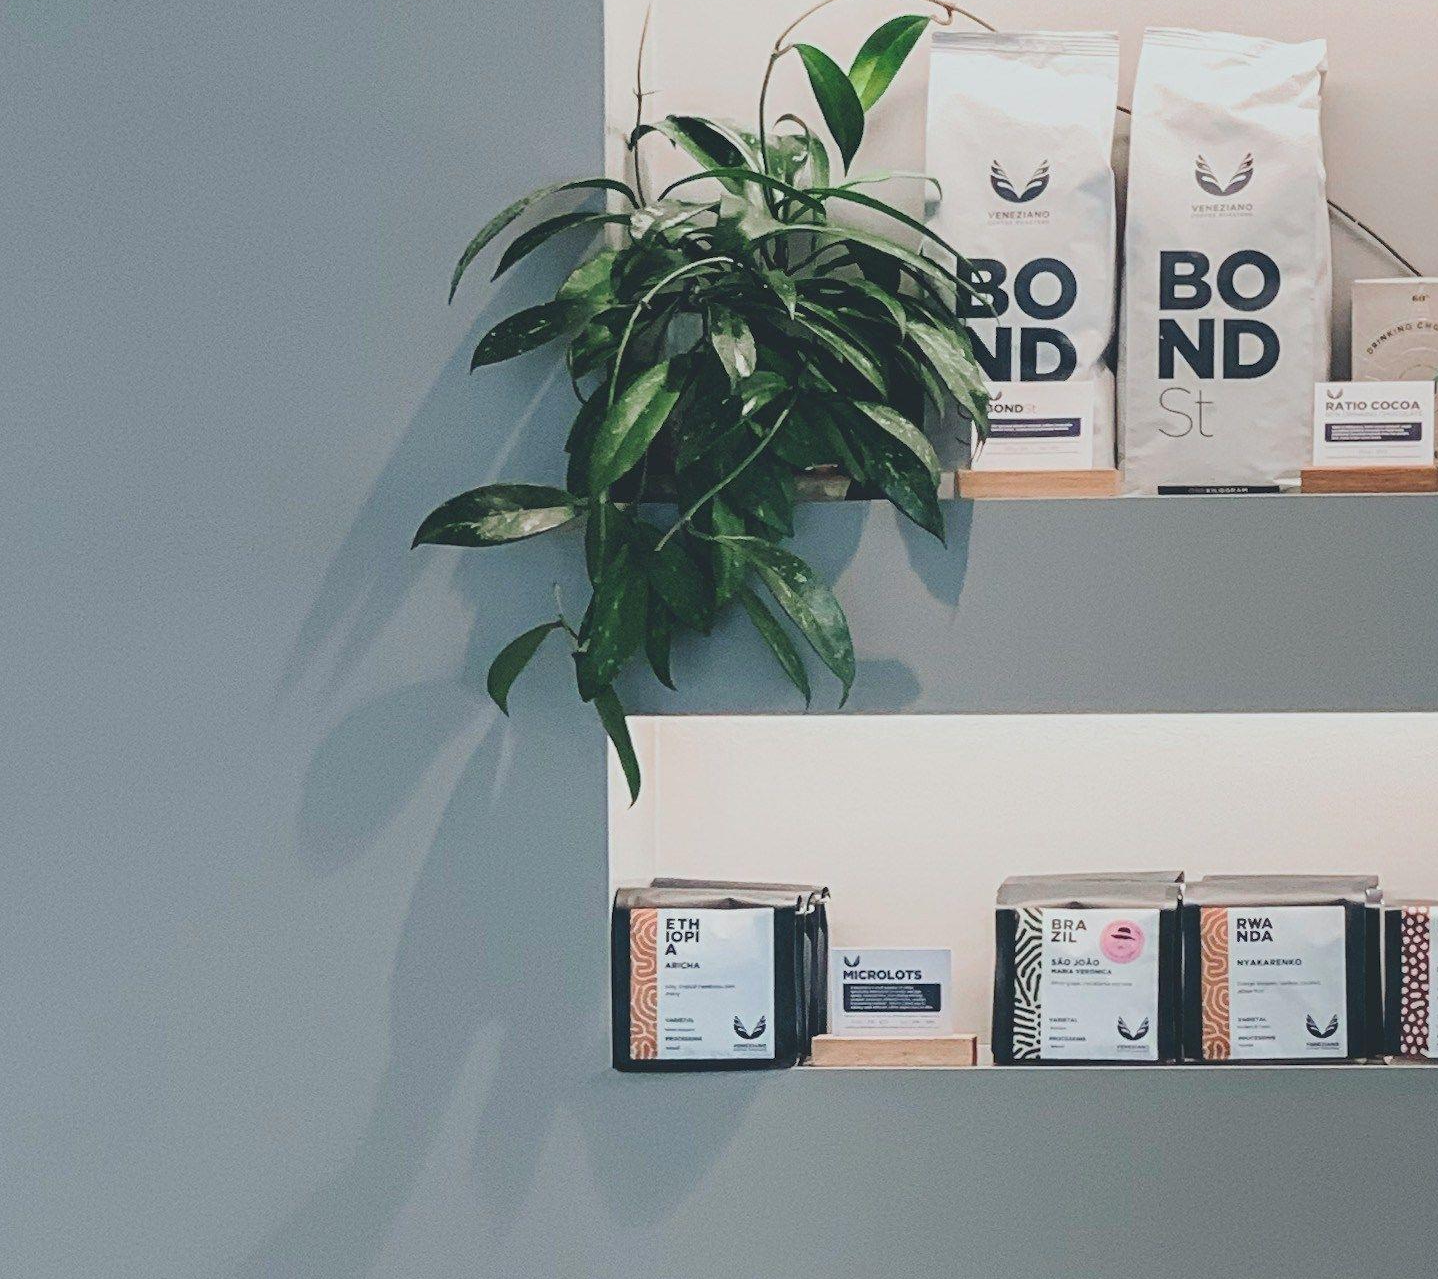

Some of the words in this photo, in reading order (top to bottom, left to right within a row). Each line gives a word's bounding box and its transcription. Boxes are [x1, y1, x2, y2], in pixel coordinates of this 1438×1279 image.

[1192, 204, 1253, 212] VENEZIANO
[988, 211, 1050, 219] VENEZIANO
[1160, 250, 1280, 312] BO
[956, 257, 1077, 320] BO
[1366, 323, 1413, 355] DRINKING
[967, 327, 1077, 382] ND
[1159, 318, 1280, 380] ND
[1326, 401, 1367, 411] RATIO
[1371, 401, 1420, 410] COCOA
[1159, 387, 1214, 438] St
[665, 918, 699, 930] ETH
[1052, 919, 1087, 931] BRA
[1237, 918, 1273, 930] RWA
[665, 931, 699, 943] IOPI
[1051, 931, 1076, 943] ZIL
[1237, 930, 1273, 943] NDA
[665, 943, 677, 956] A
[1051, 957, 1071, 966] SÃO
[1074, 956, 1099, 967] JOÃO
[843, 970, 922, 980] MICROLOTS
